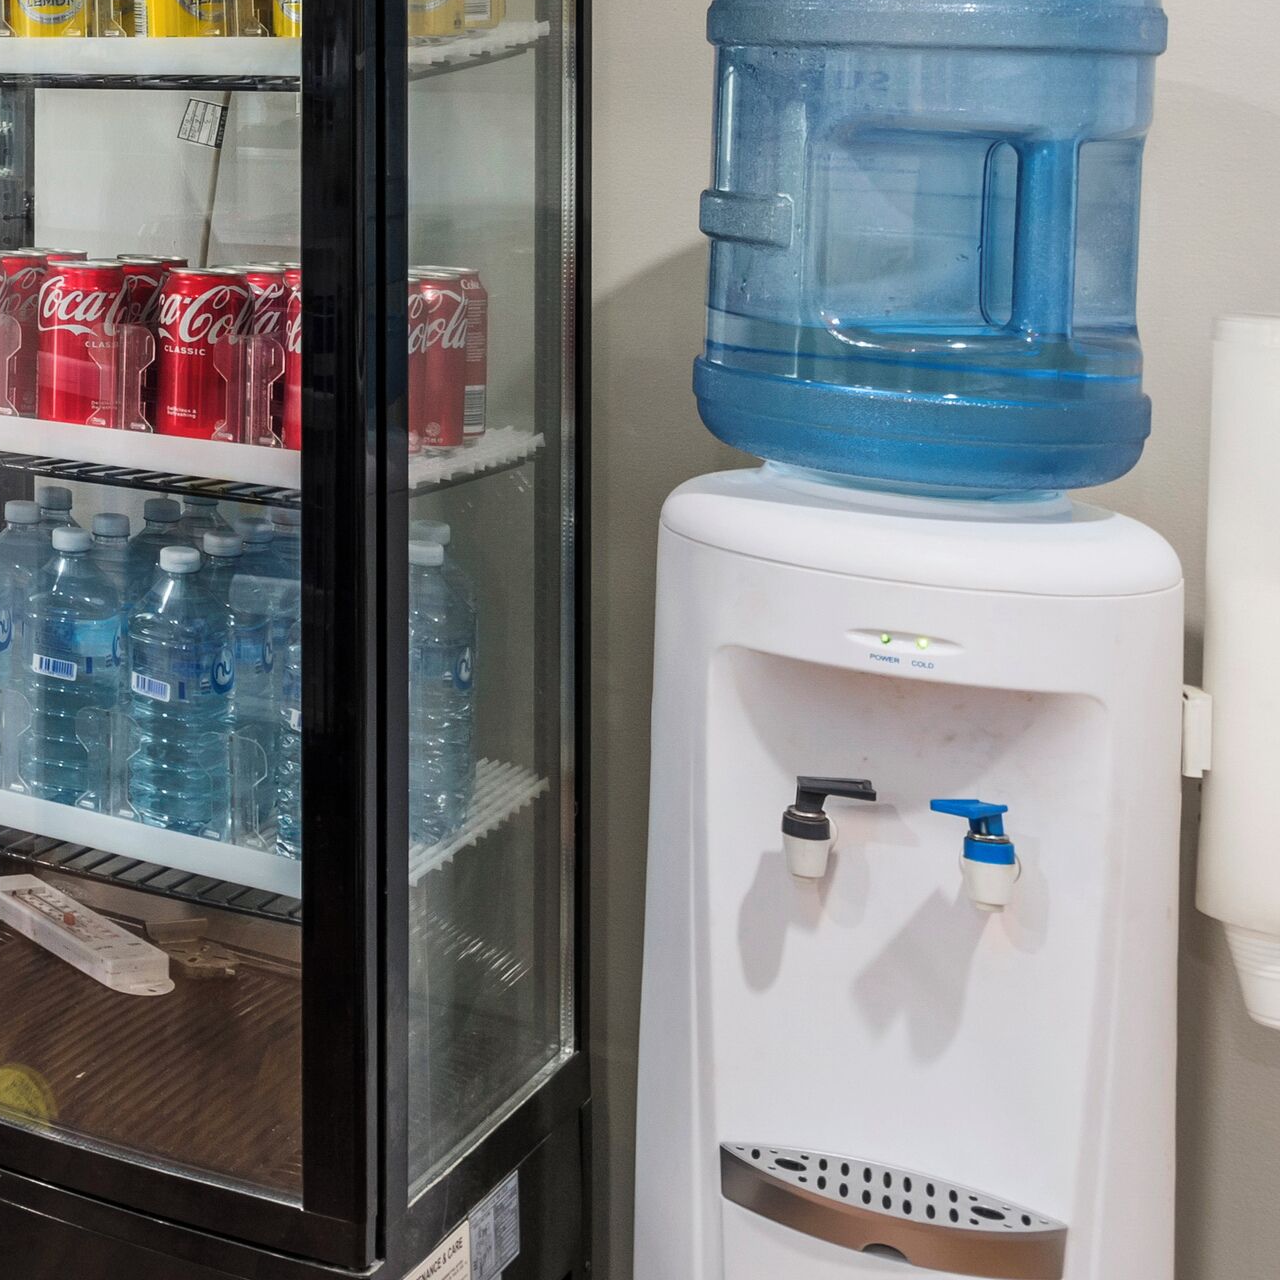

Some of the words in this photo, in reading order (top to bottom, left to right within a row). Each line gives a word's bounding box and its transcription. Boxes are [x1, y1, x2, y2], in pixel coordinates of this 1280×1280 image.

[164, 344, 206, 357] CLASSIC
[869, 652, 900, 665] POWER
[911, 659, 935, 670] COLD
[446, 1236, 464, 1260] CARE
